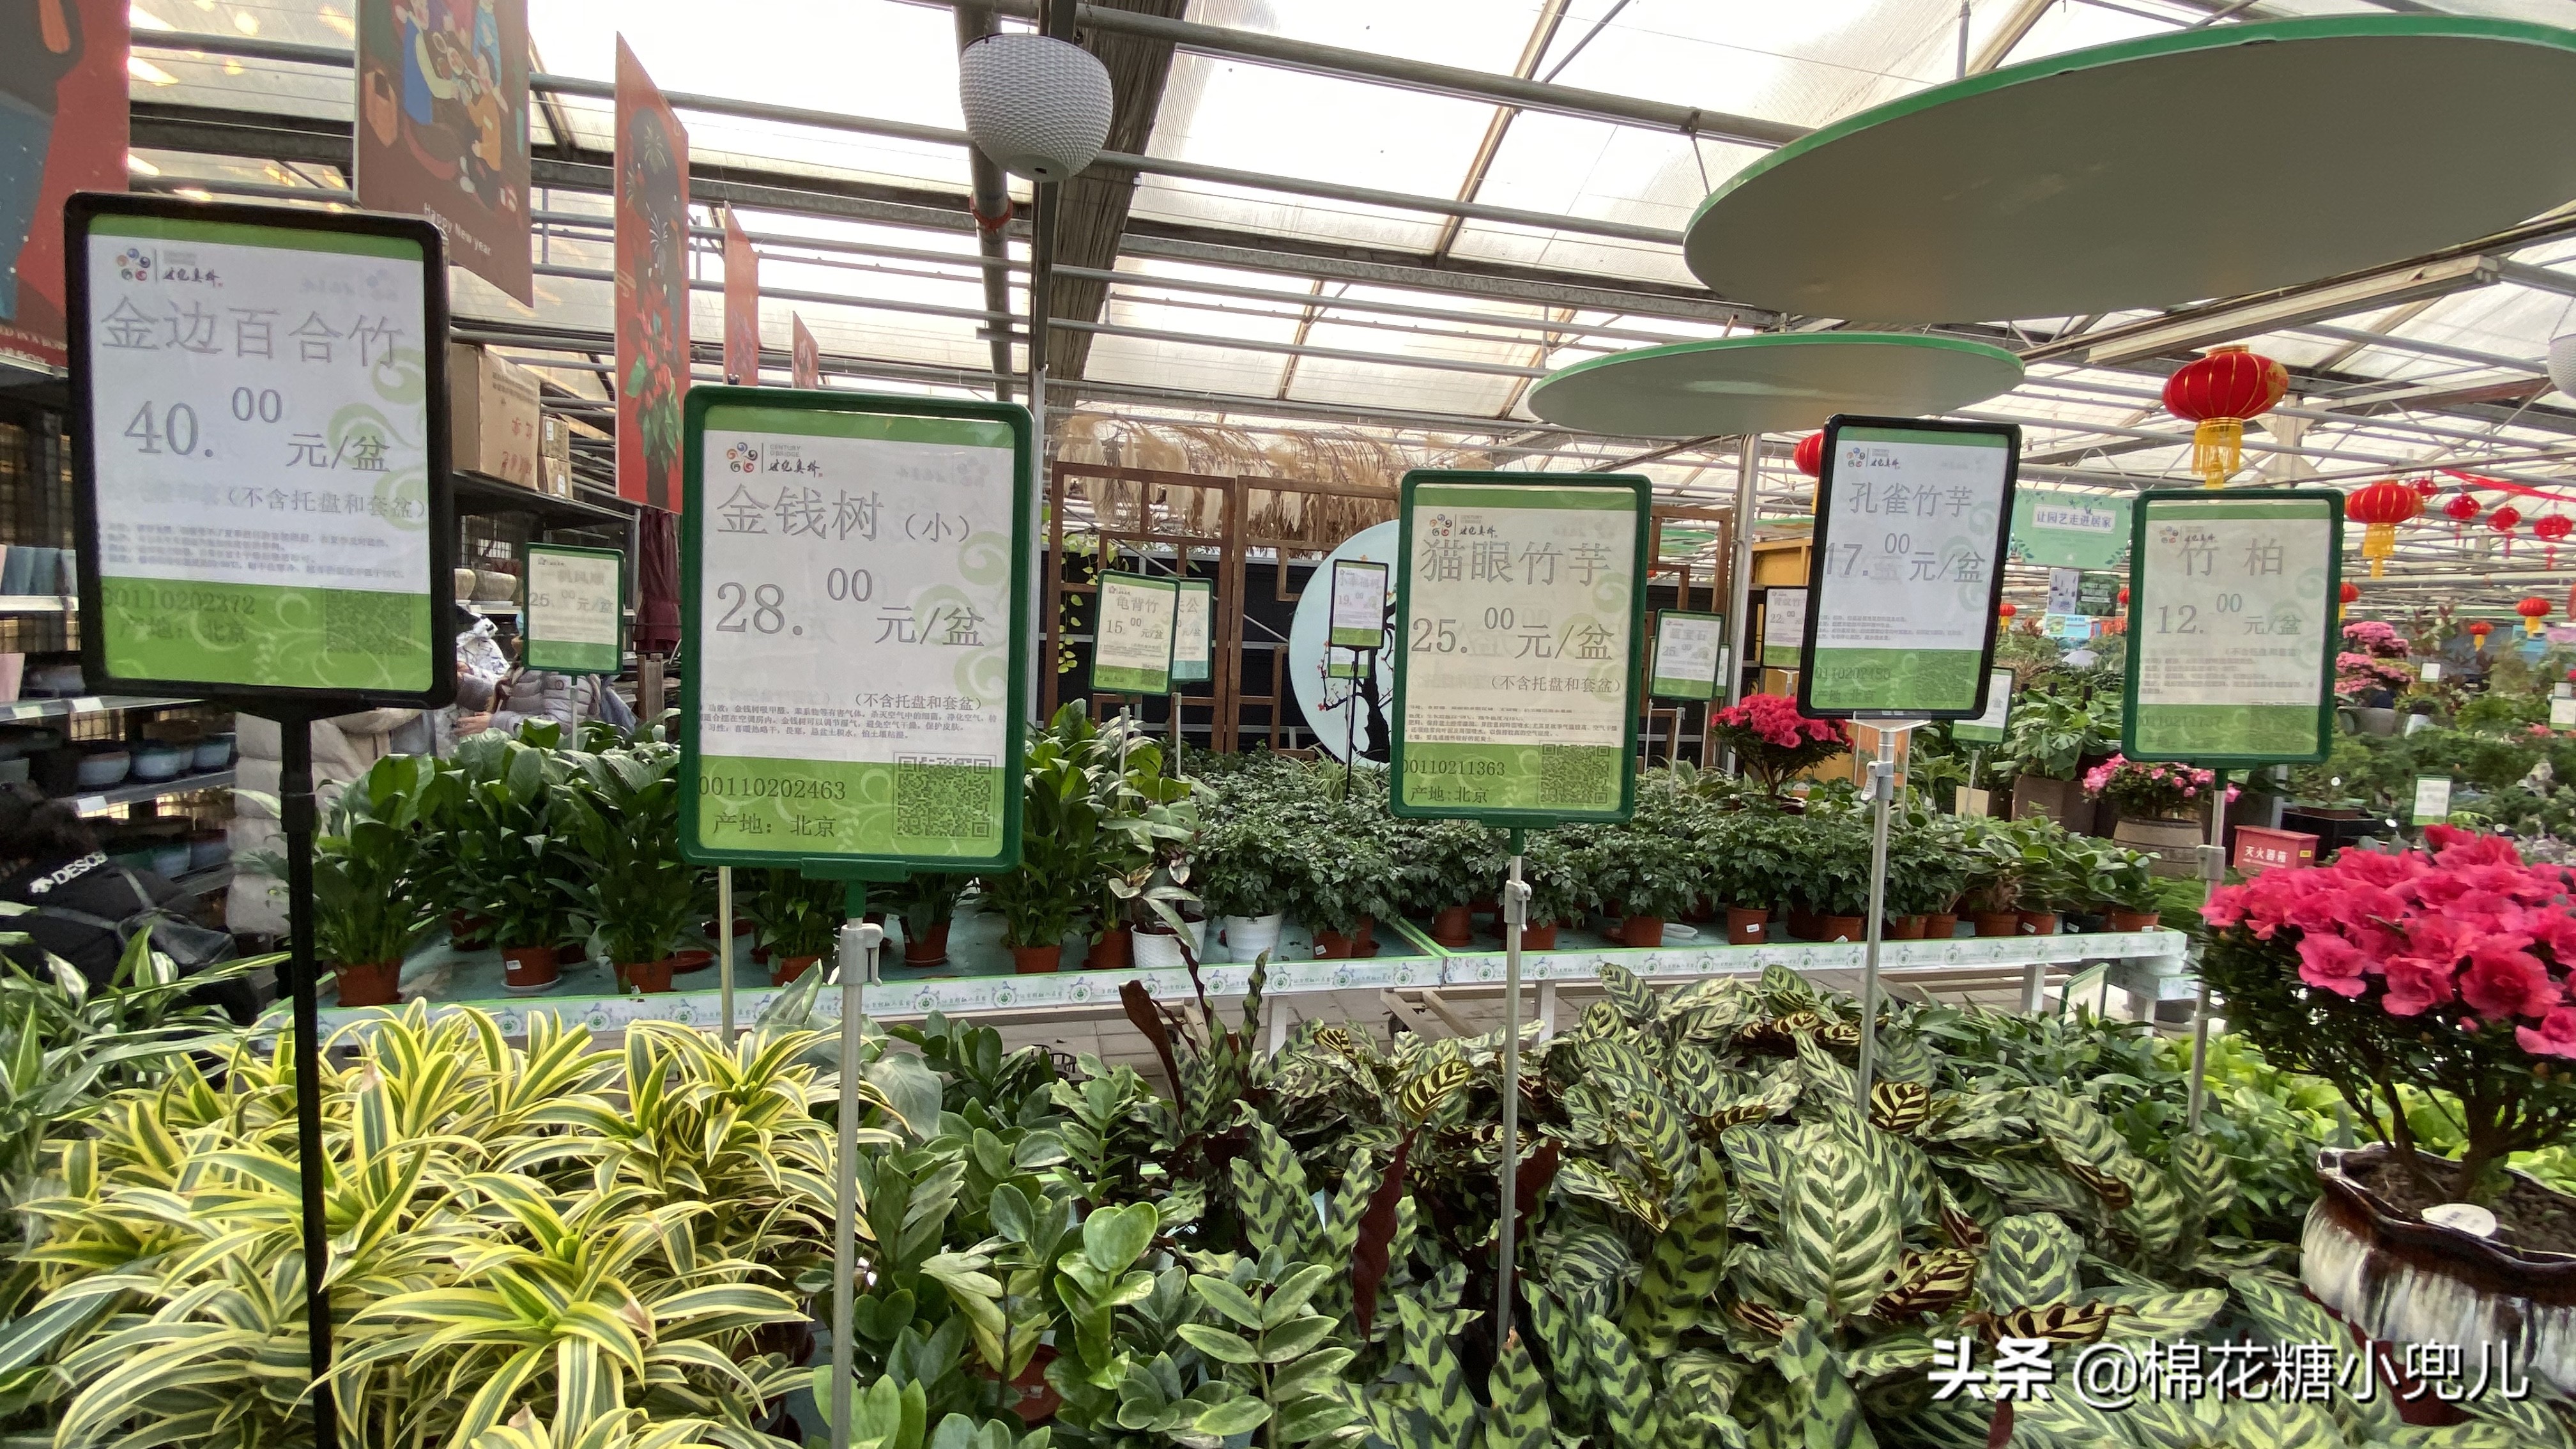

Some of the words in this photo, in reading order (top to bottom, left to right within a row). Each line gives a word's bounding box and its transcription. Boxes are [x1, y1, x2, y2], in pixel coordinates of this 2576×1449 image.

[101, 295, 404, 367] 金边百合竹
[287, 432, 391, 472] 元/盆
[229, 487, 425, 518] （不含托盘和套盆）
[1849, 481, 1973, 518] 孔雀竹芋
[2037, 510, 2112, 528] 让园艺走进居家
[1420, 538, 1612, 586] 猫眼竹芋
[1909, 550, 1985, 583] 元/盆
[1117, 595, 1159, 613] 龟背竹
[875, 606, 985, 647] 元/盆
[1140, 628, 1164, 640] 元/盆
[2243, 615, 2301, 636] 元/盆
[1514, 624, 1614, 661] 元/盆
[1491, 675, 1621, 693] （不含托盘和套盆）
[855, 693, 981, 710] （不含托盘和套盆）
[1403, 758, 1505, 776] 00110211363
[698, 776, 846, 801] 00110202463
[2244, 845, 2287, 863] 灭火器箱
